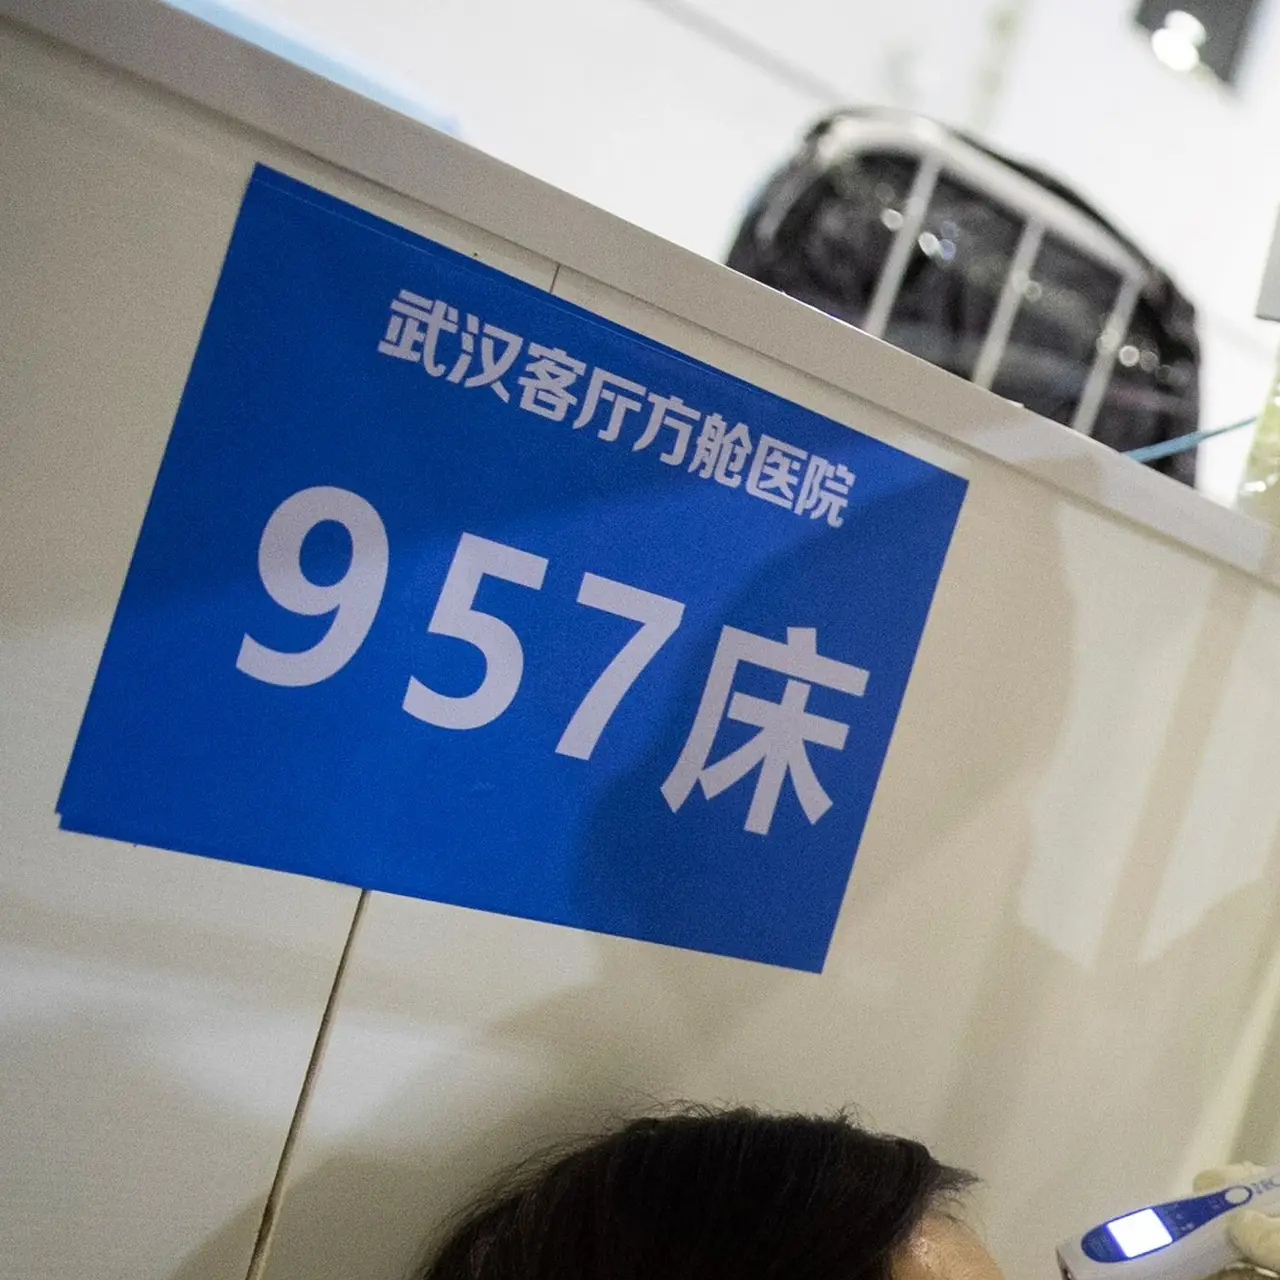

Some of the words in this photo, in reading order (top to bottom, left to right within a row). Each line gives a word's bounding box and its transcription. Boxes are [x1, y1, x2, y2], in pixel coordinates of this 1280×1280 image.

[378, 288, 856, 529] 武汉客厅方舱医院
[235, 486, 870, 836] 957床
